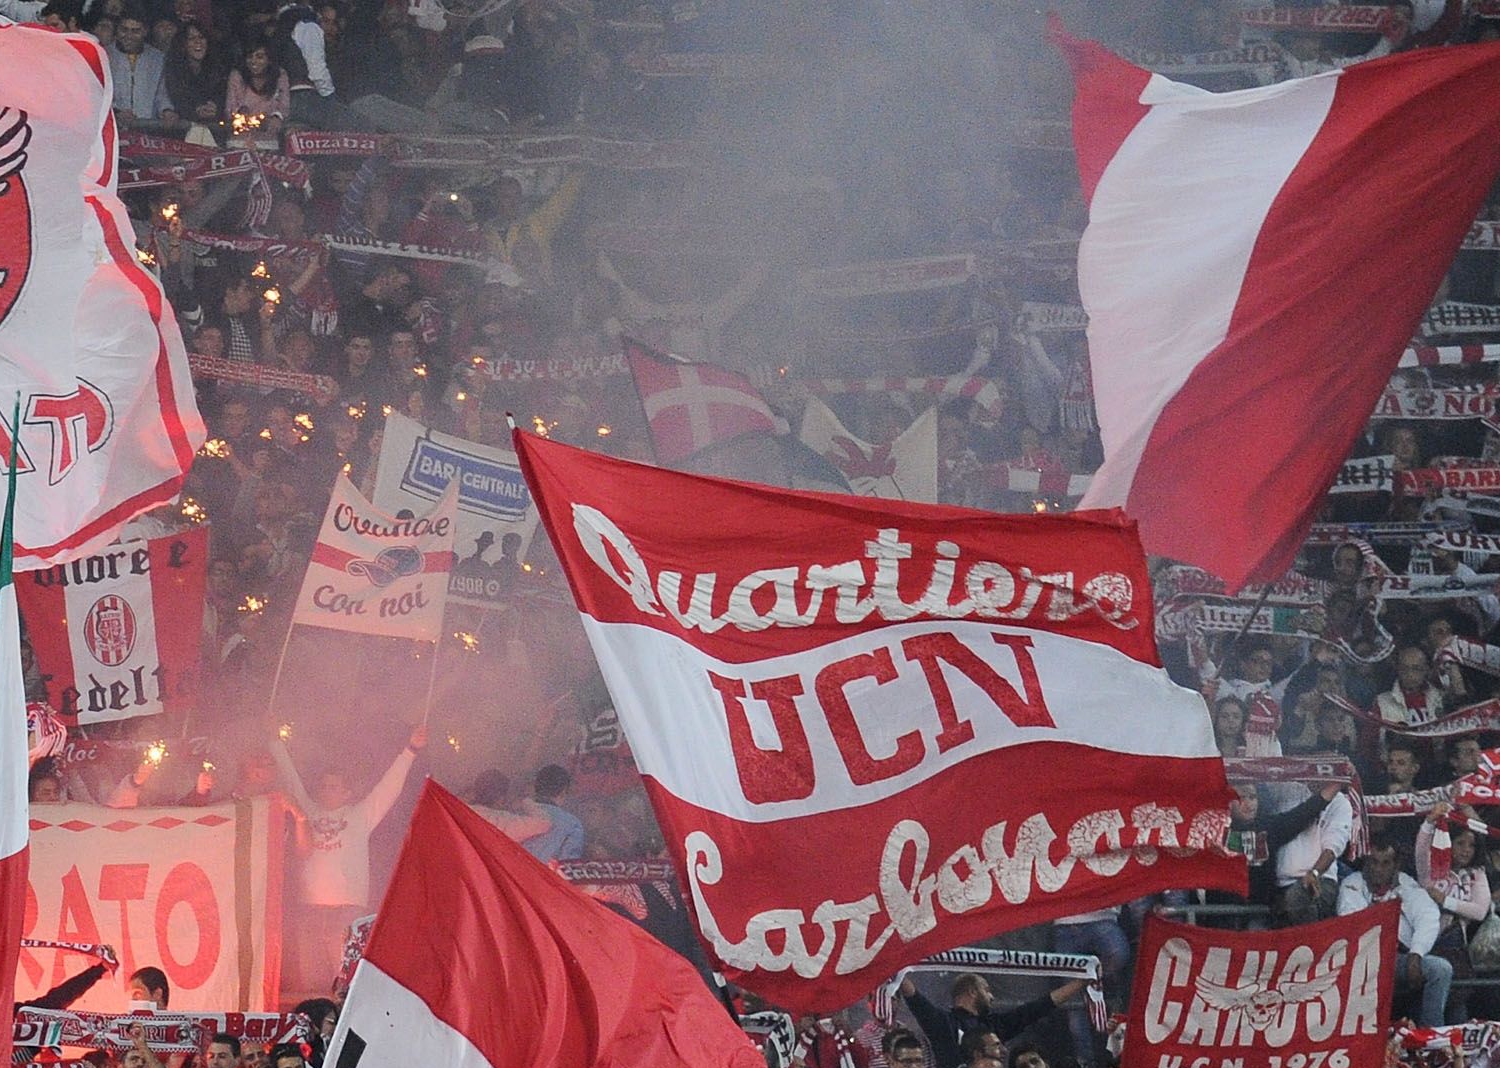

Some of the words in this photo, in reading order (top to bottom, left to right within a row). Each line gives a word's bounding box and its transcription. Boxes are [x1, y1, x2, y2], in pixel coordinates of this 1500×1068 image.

[380, 583, 430, 618] noi
[707, 630, 1056, 806] UCN
[1144, 925, 1382, 1049] CANOSA
